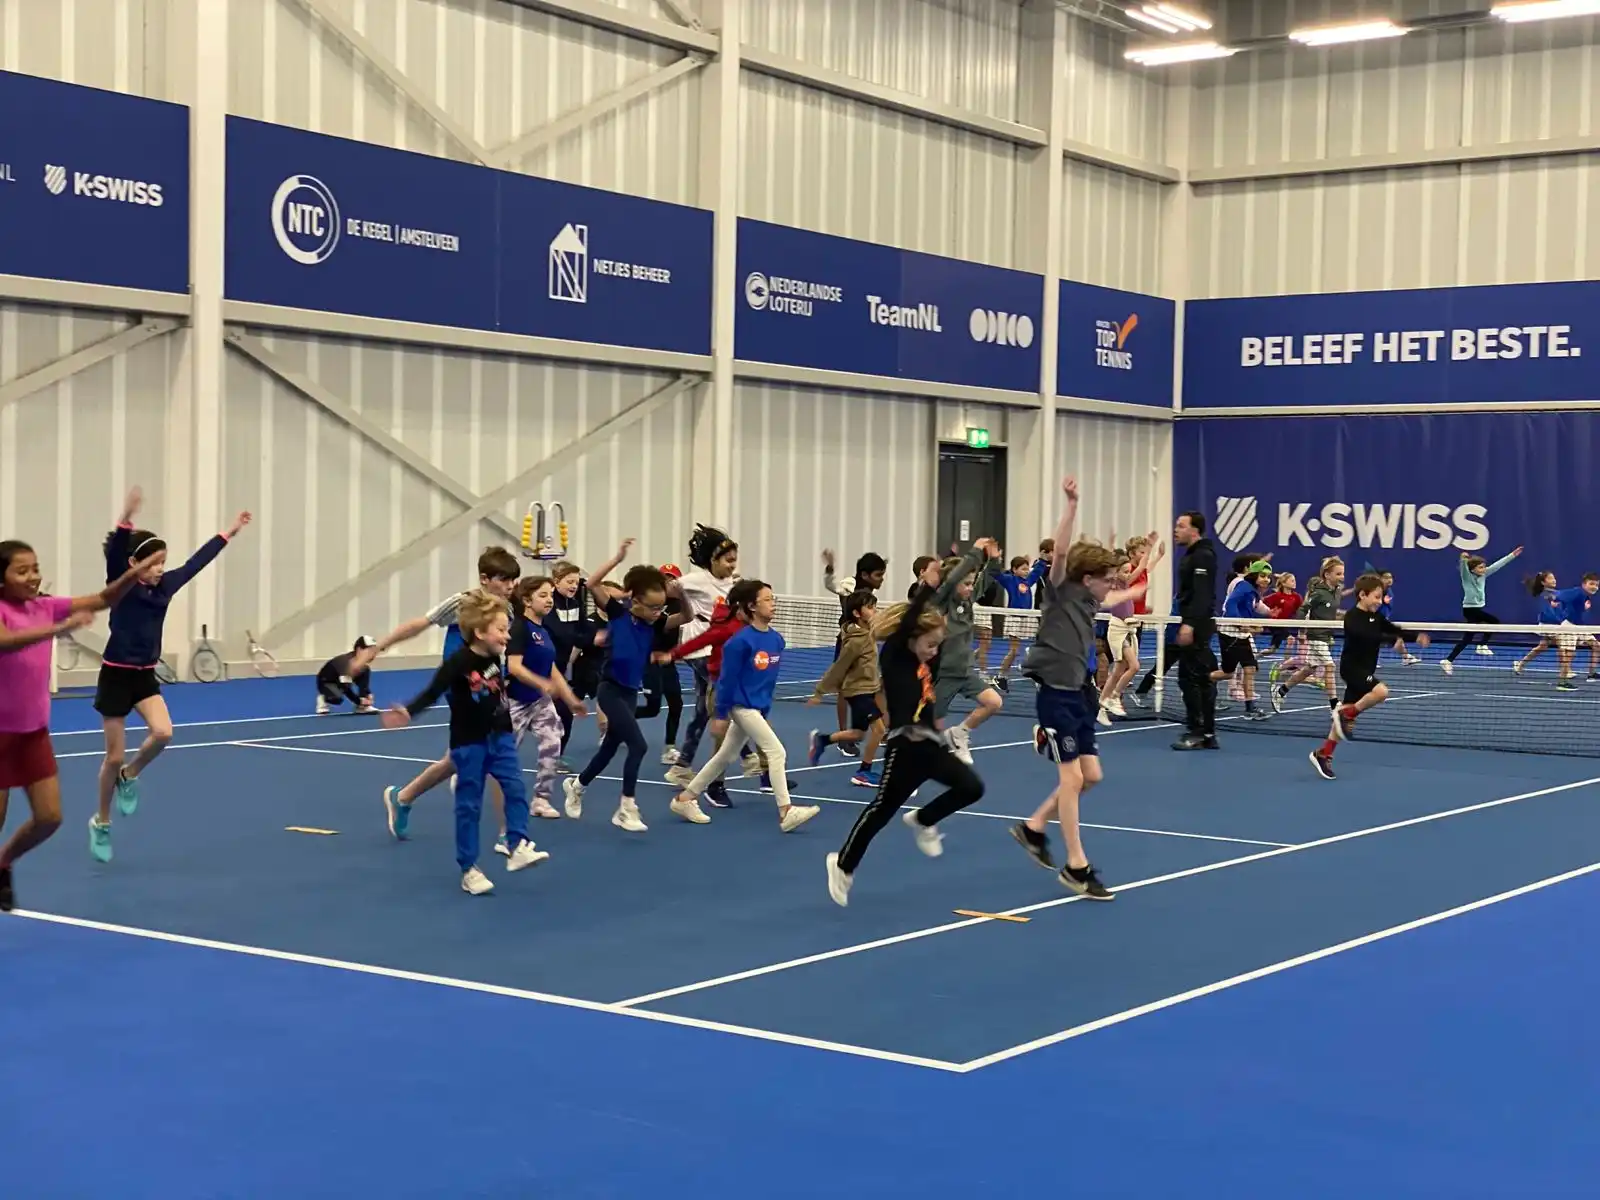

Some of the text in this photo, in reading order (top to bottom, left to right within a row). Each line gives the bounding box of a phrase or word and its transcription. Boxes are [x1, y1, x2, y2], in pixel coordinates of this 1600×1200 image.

[288, 202, 324, 237] NTC
[347, 218, 459, 252] DE KEGEL AMSTELVEEN
[593, 258, 671, 284] NETJES BEHEER
[769, 276, 842, 303] NEDERLANDSE
[866, 295, 942, 333] TeamNL
[1095, 328, 1117, 348] TOP
[1241, 325, 1582, 367] BELEEF HET BESTE.
[1095, 348, 1133, 370] TENNIS
